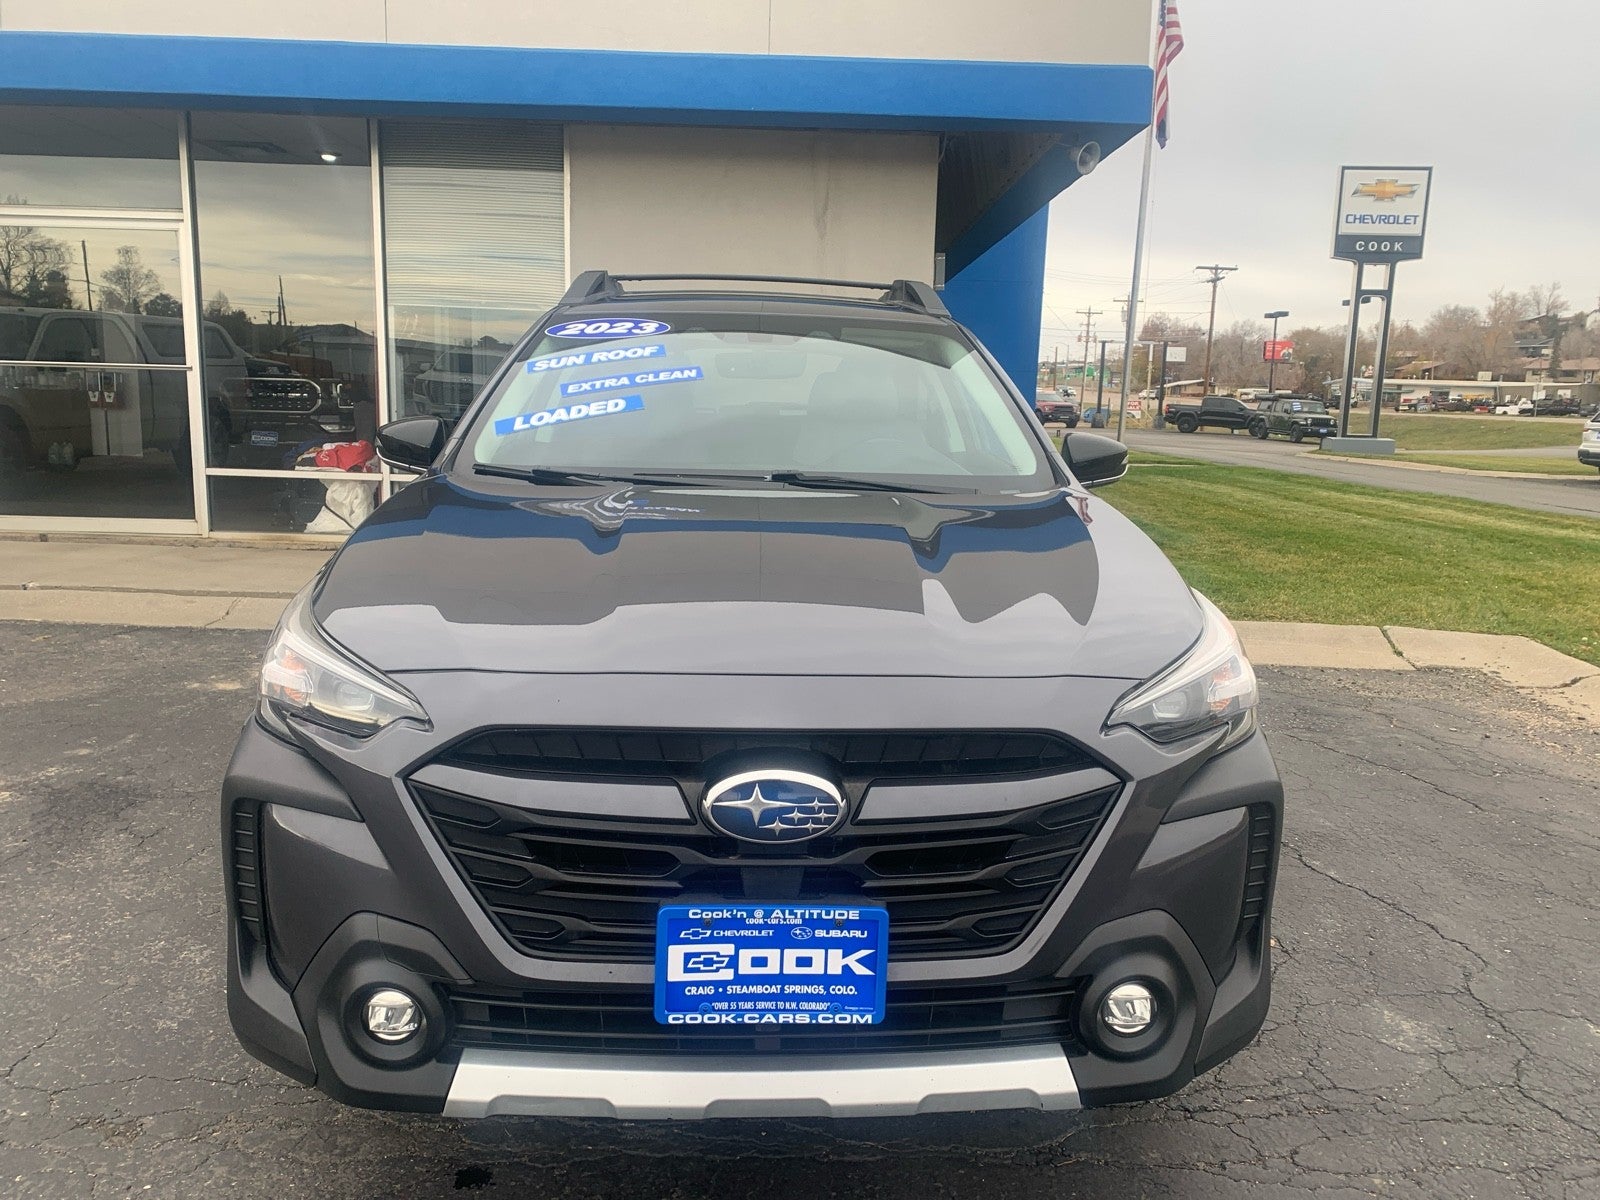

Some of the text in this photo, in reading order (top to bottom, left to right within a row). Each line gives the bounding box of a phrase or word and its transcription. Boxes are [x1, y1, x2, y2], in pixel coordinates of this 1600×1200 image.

[1345, 214, 1419, 224] CHEVROLET
[1356, 241, 1404, 252] COOK
[557, 322, 662, 335] 2023
[532, 345, 660, 371] SUN ROOF
[566, 369, 697, 394] EXTRA CLEAN
[512, 398, 627, 431] LOADED
[688, 909, 860, 920] Cook'n @ ALTITUDE
[745, 917, 803, 925] cook-cars.com
[713, 929, 868, 938] CHEVROLET SUBARU
[685, 984, 858, 996] CRAIG STEAMBOAT SPRINGS, COLO.
[730, 1002, 737, 1010] 55
[738, 1001, 754, 1010] YEARS
[755, 1001, 776, 1010] SERVICE
[777, 1001, 785, 1010] TO
[785, 1001, 798, 1010] N.W.
[667, 1013, 873, 1024] COOK-CARS.COM
